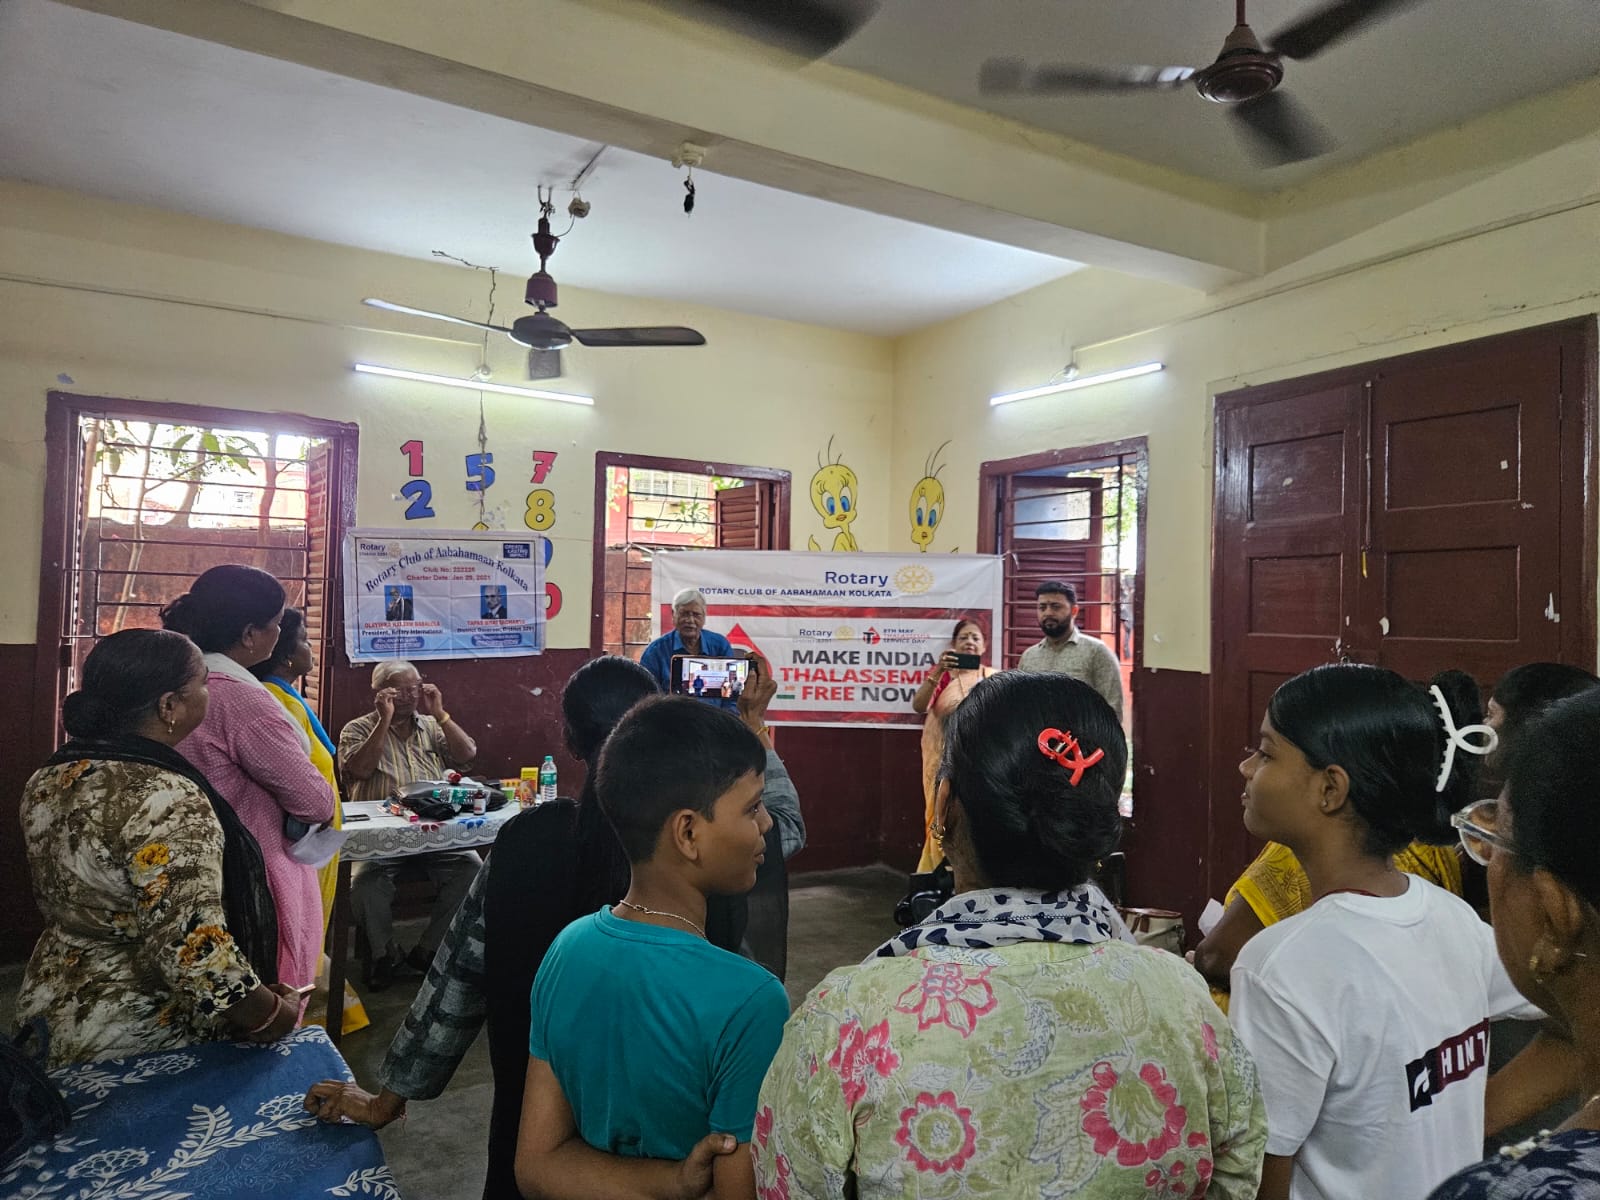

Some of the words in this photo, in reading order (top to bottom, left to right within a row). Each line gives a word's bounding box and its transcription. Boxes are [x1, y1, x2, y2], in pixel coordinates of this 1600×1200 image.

[400, 440, 424, 477] 1
[530, 450, 558, 484] 7
[465, 452, 495, 491] 5
[400, 479, 435, 520] 2
[524, 488, 556, 531] 8
[360, 543, 386, 551] Rotary
[365, 563, 397, 592] Rotary
[398, 551, 421, 569] Club
[423, 547, 433, 559] of
[436, 545, 494, 567] Aabahamaan
[496, 560, 528, 591] Kolkata
[825, 571, 888, 587] Rotary
[737, 588, 762, 596] CLUB
[765, 588, 778, 596] OF
[780, 588, 846, 597] AABAHAMAAN
[799, 628, 832, 637] Rotary
[792, 650, 860, 664] MAKE
[867, 651, 935, 666] INDIA
[802, 686, 855, 701] FREE
